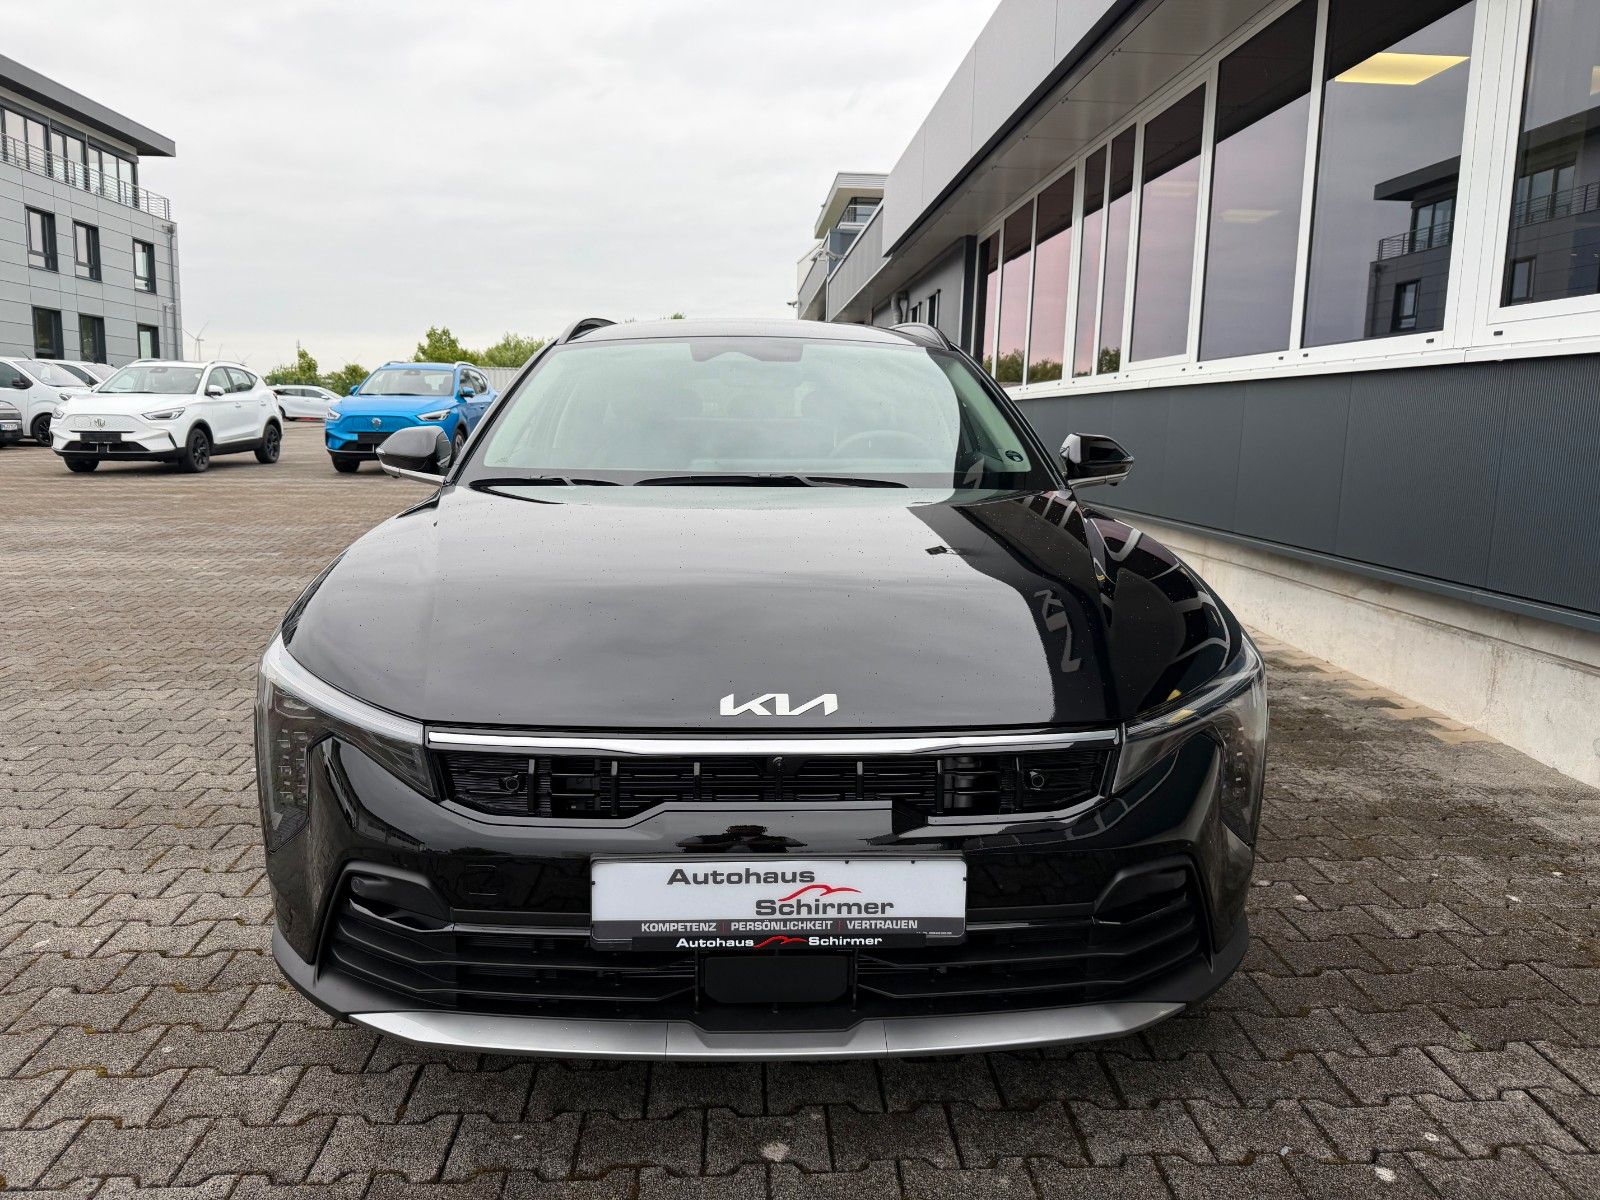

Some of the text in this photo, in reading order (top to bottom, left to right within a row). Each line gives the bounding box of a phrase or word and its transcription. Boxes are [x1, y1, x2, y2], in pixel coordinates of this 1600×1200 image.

[720, 693, 838, 716] KIA
[667, 868, 815, 885] Autohaus
[755, 899, 894, 916] Schirmer
[640, 919, 918, 932] KOMPETENZ PERSÖNLICHKEIT VERTRAUEN
[676, 936, 883, 948] Autohaus Schirmer
